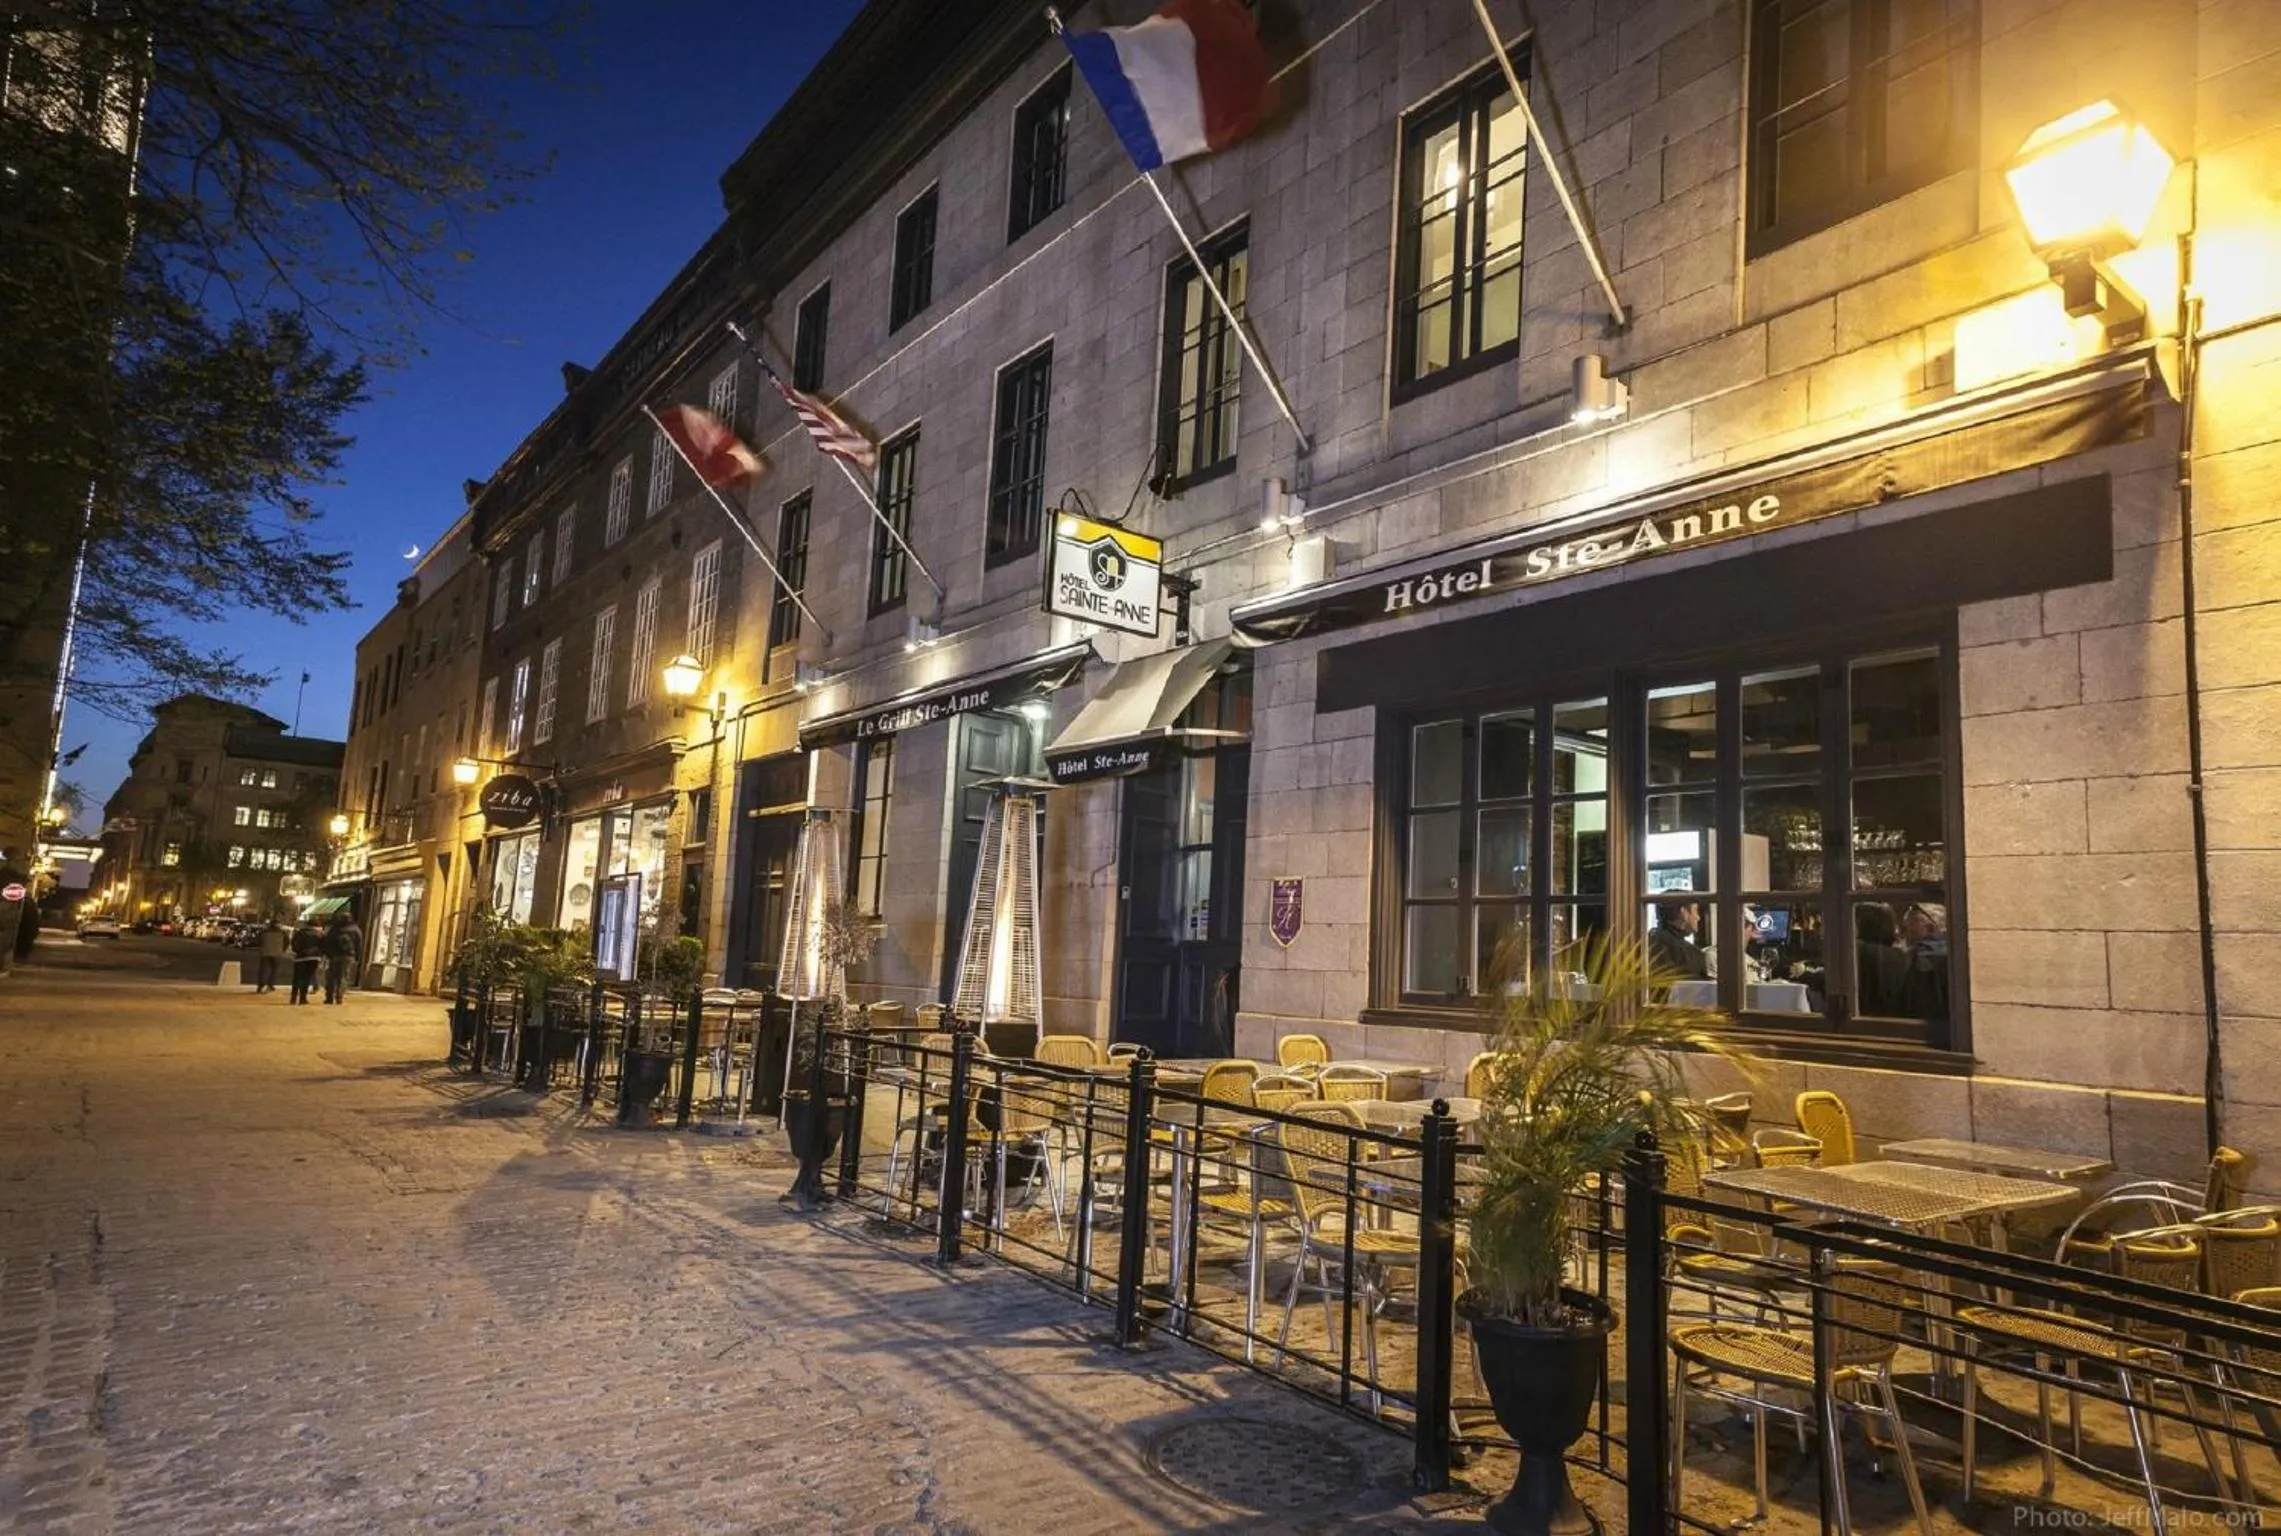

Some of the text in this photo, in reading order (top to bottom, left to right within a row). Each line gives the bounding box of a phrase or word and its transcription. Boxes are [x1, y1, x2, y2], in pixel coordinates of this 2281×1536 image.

[1384, 494, 1780, 613] Hôtel Ste-Anne
[1060, 573, 1091, 590] HÔTEL
[857, 690, 989, 737] Le Grill Ste-Anne
[1057, 751, 1150, 776] Hôtel Ste-Anne
